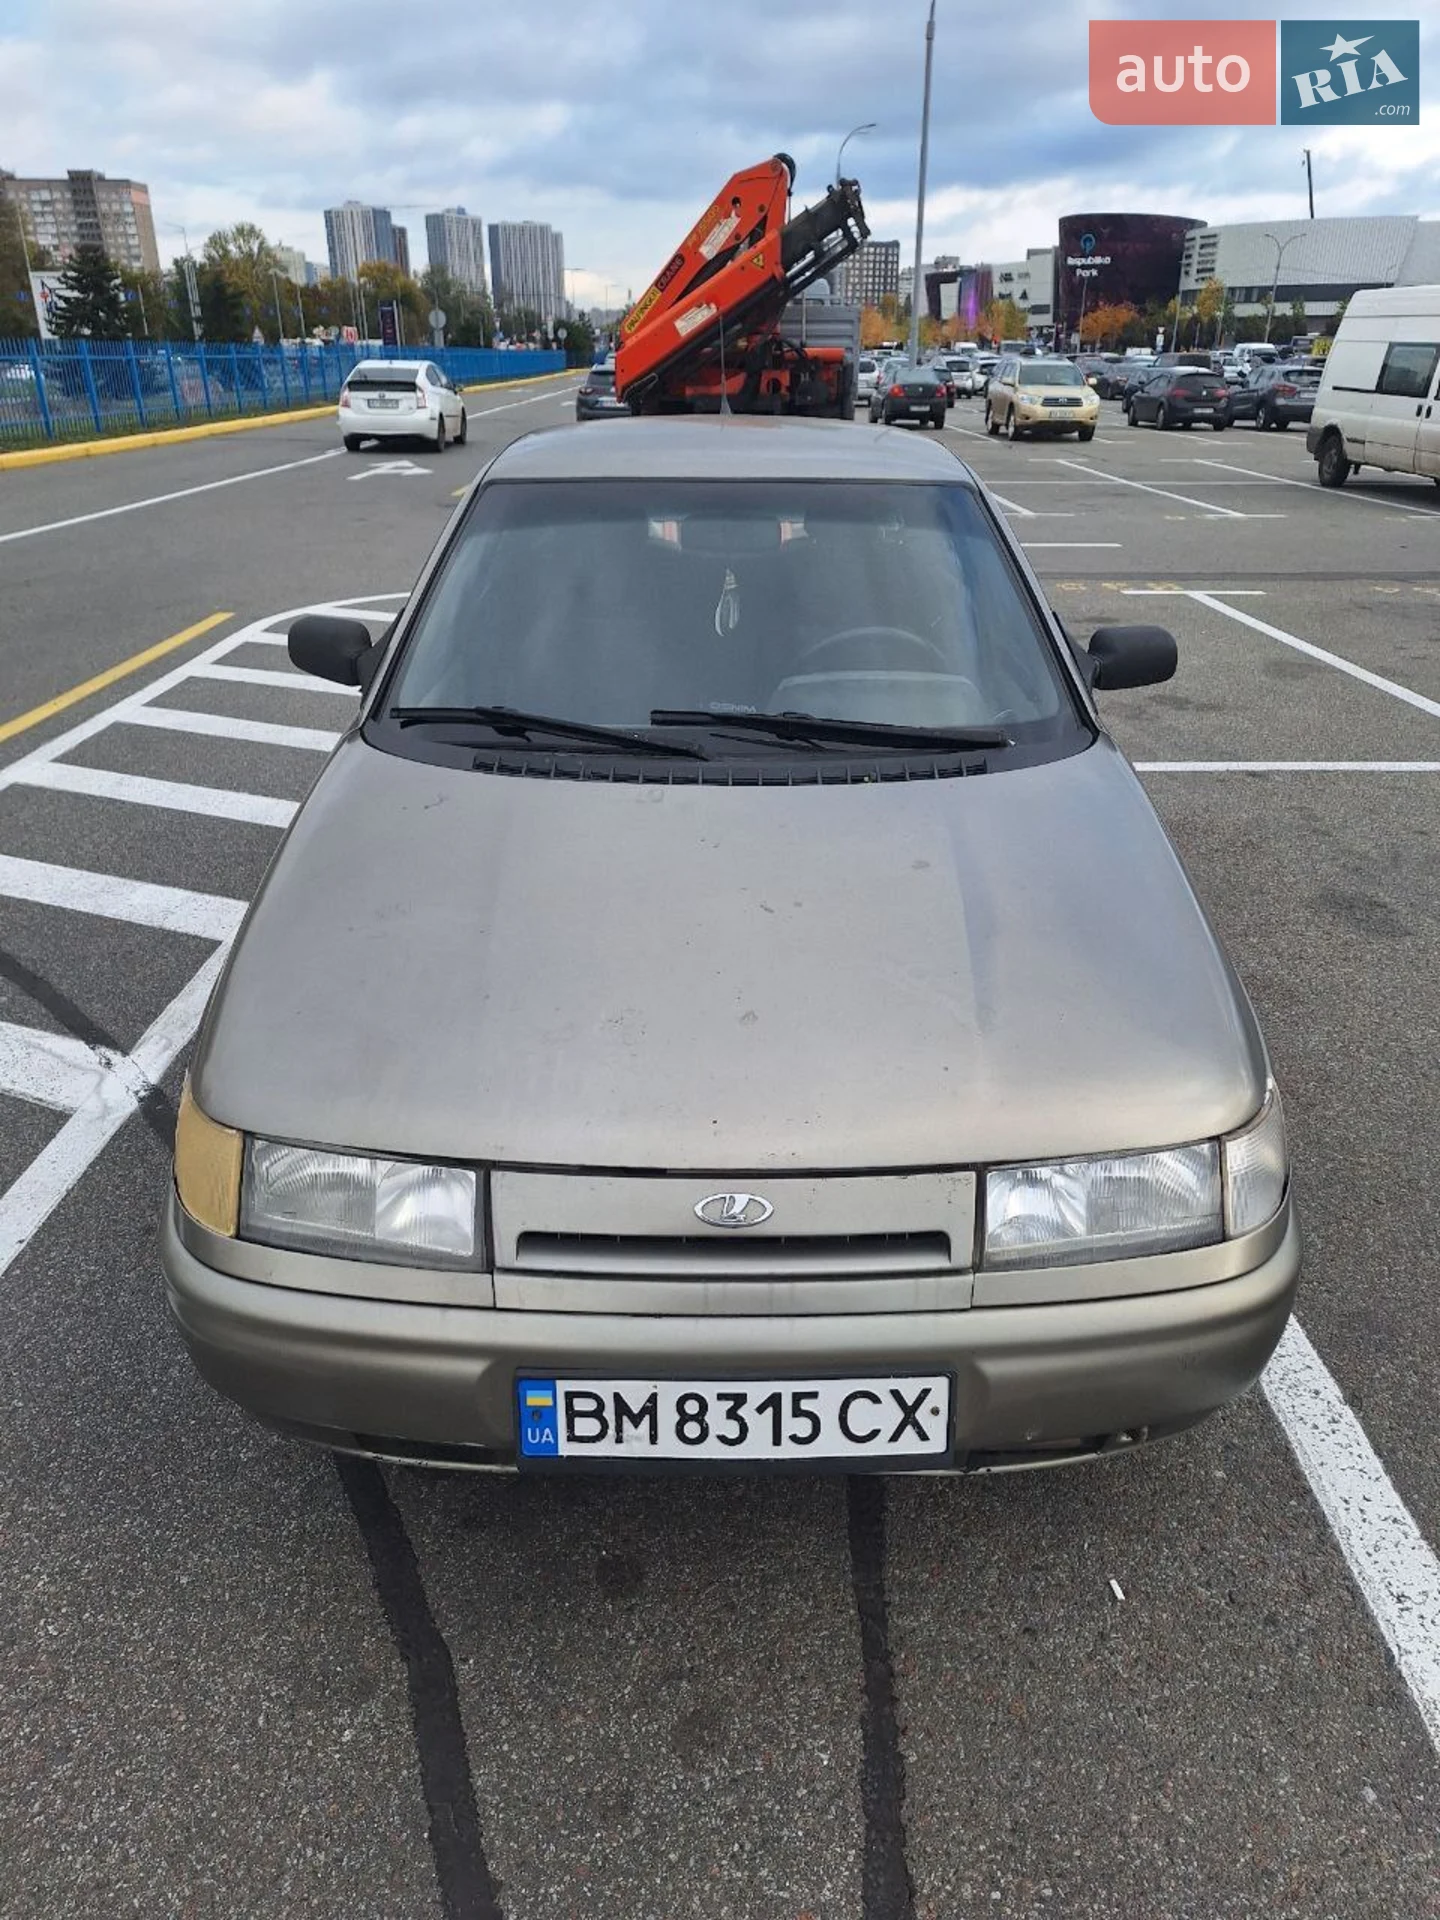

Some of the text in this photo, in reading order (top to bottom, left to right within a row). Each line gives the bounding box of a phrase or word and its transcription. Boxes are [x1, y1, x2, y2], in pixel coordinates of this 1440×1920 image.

[1076, 268, 1099, 278] Park
[564, 1388, 932, 1447] BM 8315 CX
[528, 1428, 555, 1445] UA
